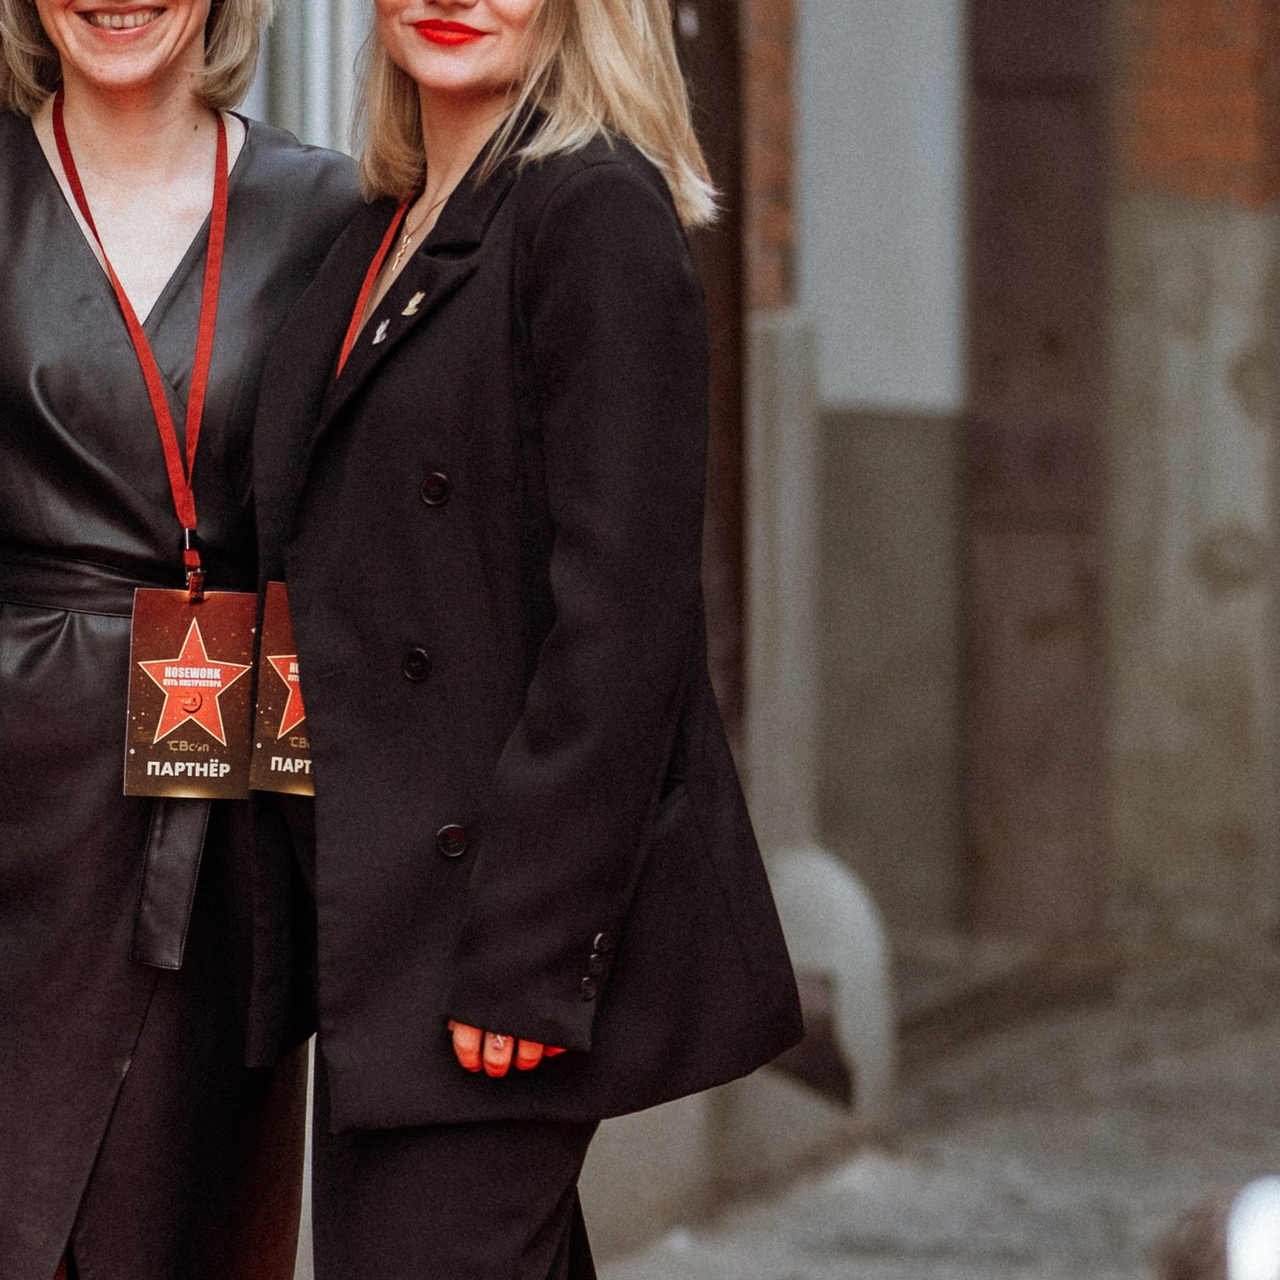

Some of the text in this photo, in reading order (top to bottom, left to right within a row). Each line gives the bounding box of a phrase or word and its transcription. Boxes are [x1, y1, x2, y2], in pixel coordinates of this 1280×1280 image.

[164, 666, 221, 679] NOSEWORK
[146, 758, 231, 778] ПАРТНЁР
[271, 756, 313, 775] ПАРТ
